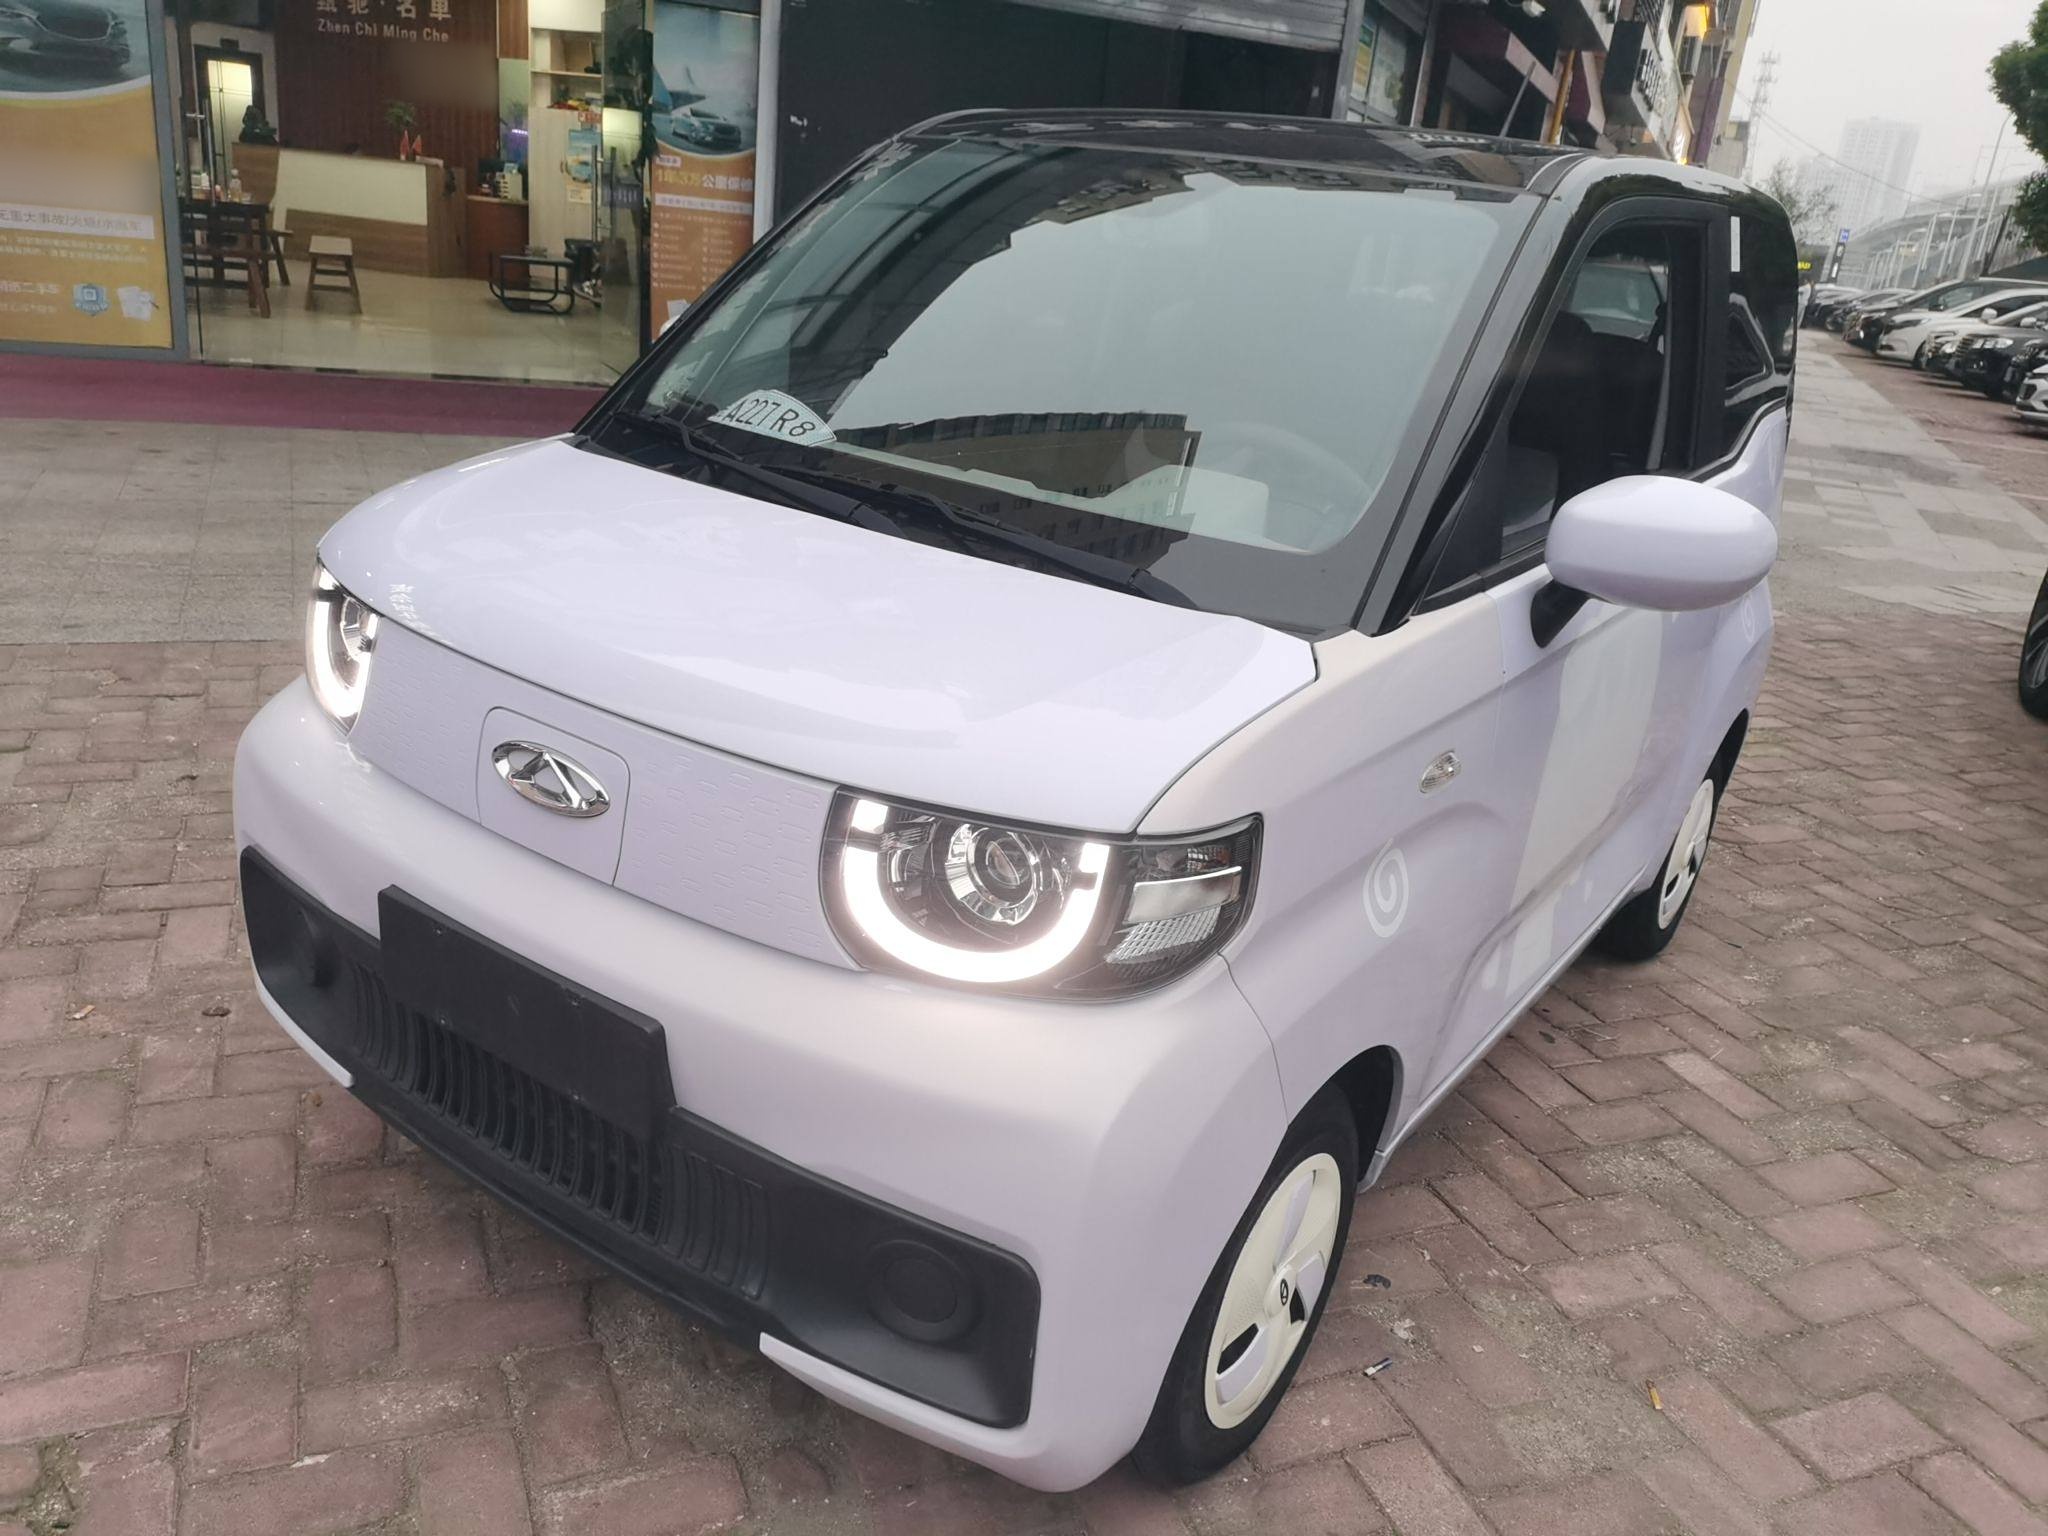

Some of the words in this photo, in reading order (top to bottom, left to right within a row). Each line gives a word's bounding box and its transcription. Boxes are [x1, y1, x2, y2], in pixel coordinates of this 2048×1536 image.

[317, 18, 350, 34] Zhen
[355, 21, 378, 37] Chi
[383, 24, 417, 42] Ming
[422, 27, 449, 43] Che
[721, 398, 816, 437] A227R8
